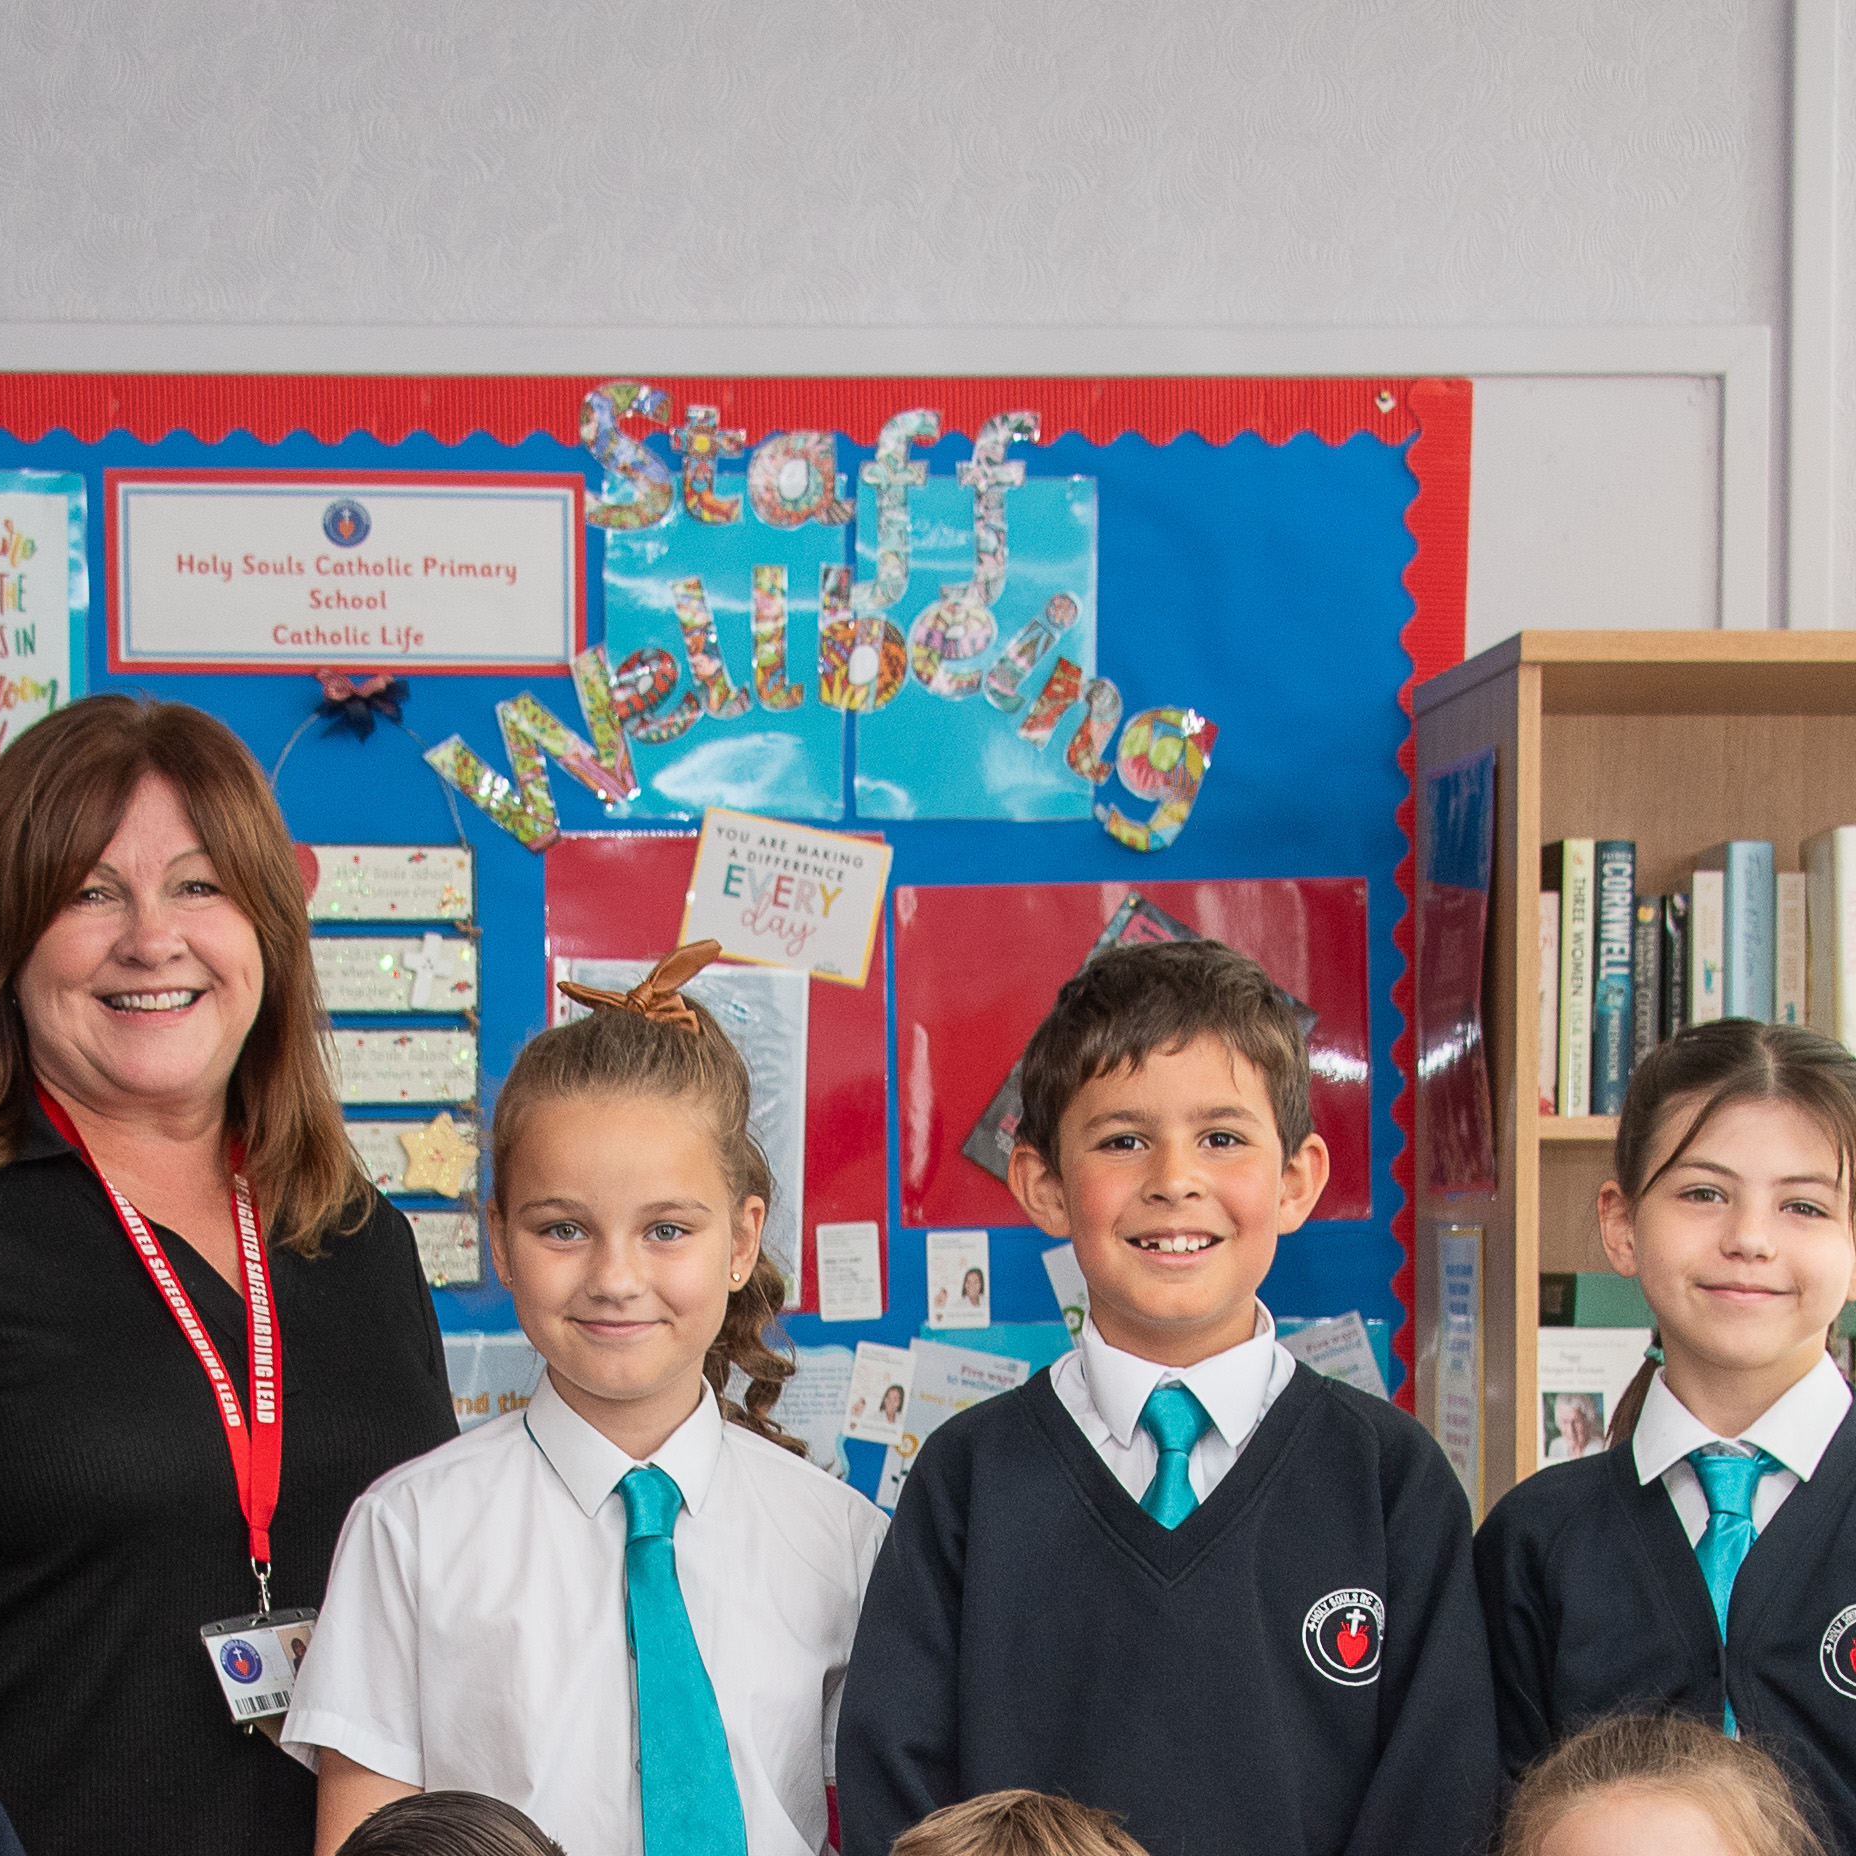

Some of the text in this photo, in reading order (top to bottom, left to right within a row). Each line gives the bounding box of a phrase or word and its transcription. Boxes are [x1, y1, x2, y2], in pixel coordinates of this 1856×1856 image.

[580, 383, 1042, 606] Staff
[177, 553, 518, 585] Holy Souls Catholic Primary
[309, 589, 387, 611] School
[15, 622, 36, 656] IN
[273, 623, 424, 654] Catholic Life
[424, 565, 1219, 853] Wellbeing
[716, 825, 864, 870] YOU ARE MAKING
[729, 847, 845, 883] A DIFFERENCE
[722, 862, 843, 918] EVERY
[1572, 878, 1586, 924] THREE
[741, 890, 817, 958] day
[1600, 862, 1633, 980] CORNWELL
[1570, 930, 1585, 998] WOMEN
[148, 1257, 225, 1380] SAFEGUARDING
[216, 1382, 242, 1427] LEAD
[245, 1260, 275, 1379] SAFEGUARDING
[254, 1380, 276, 1425] LEAD
